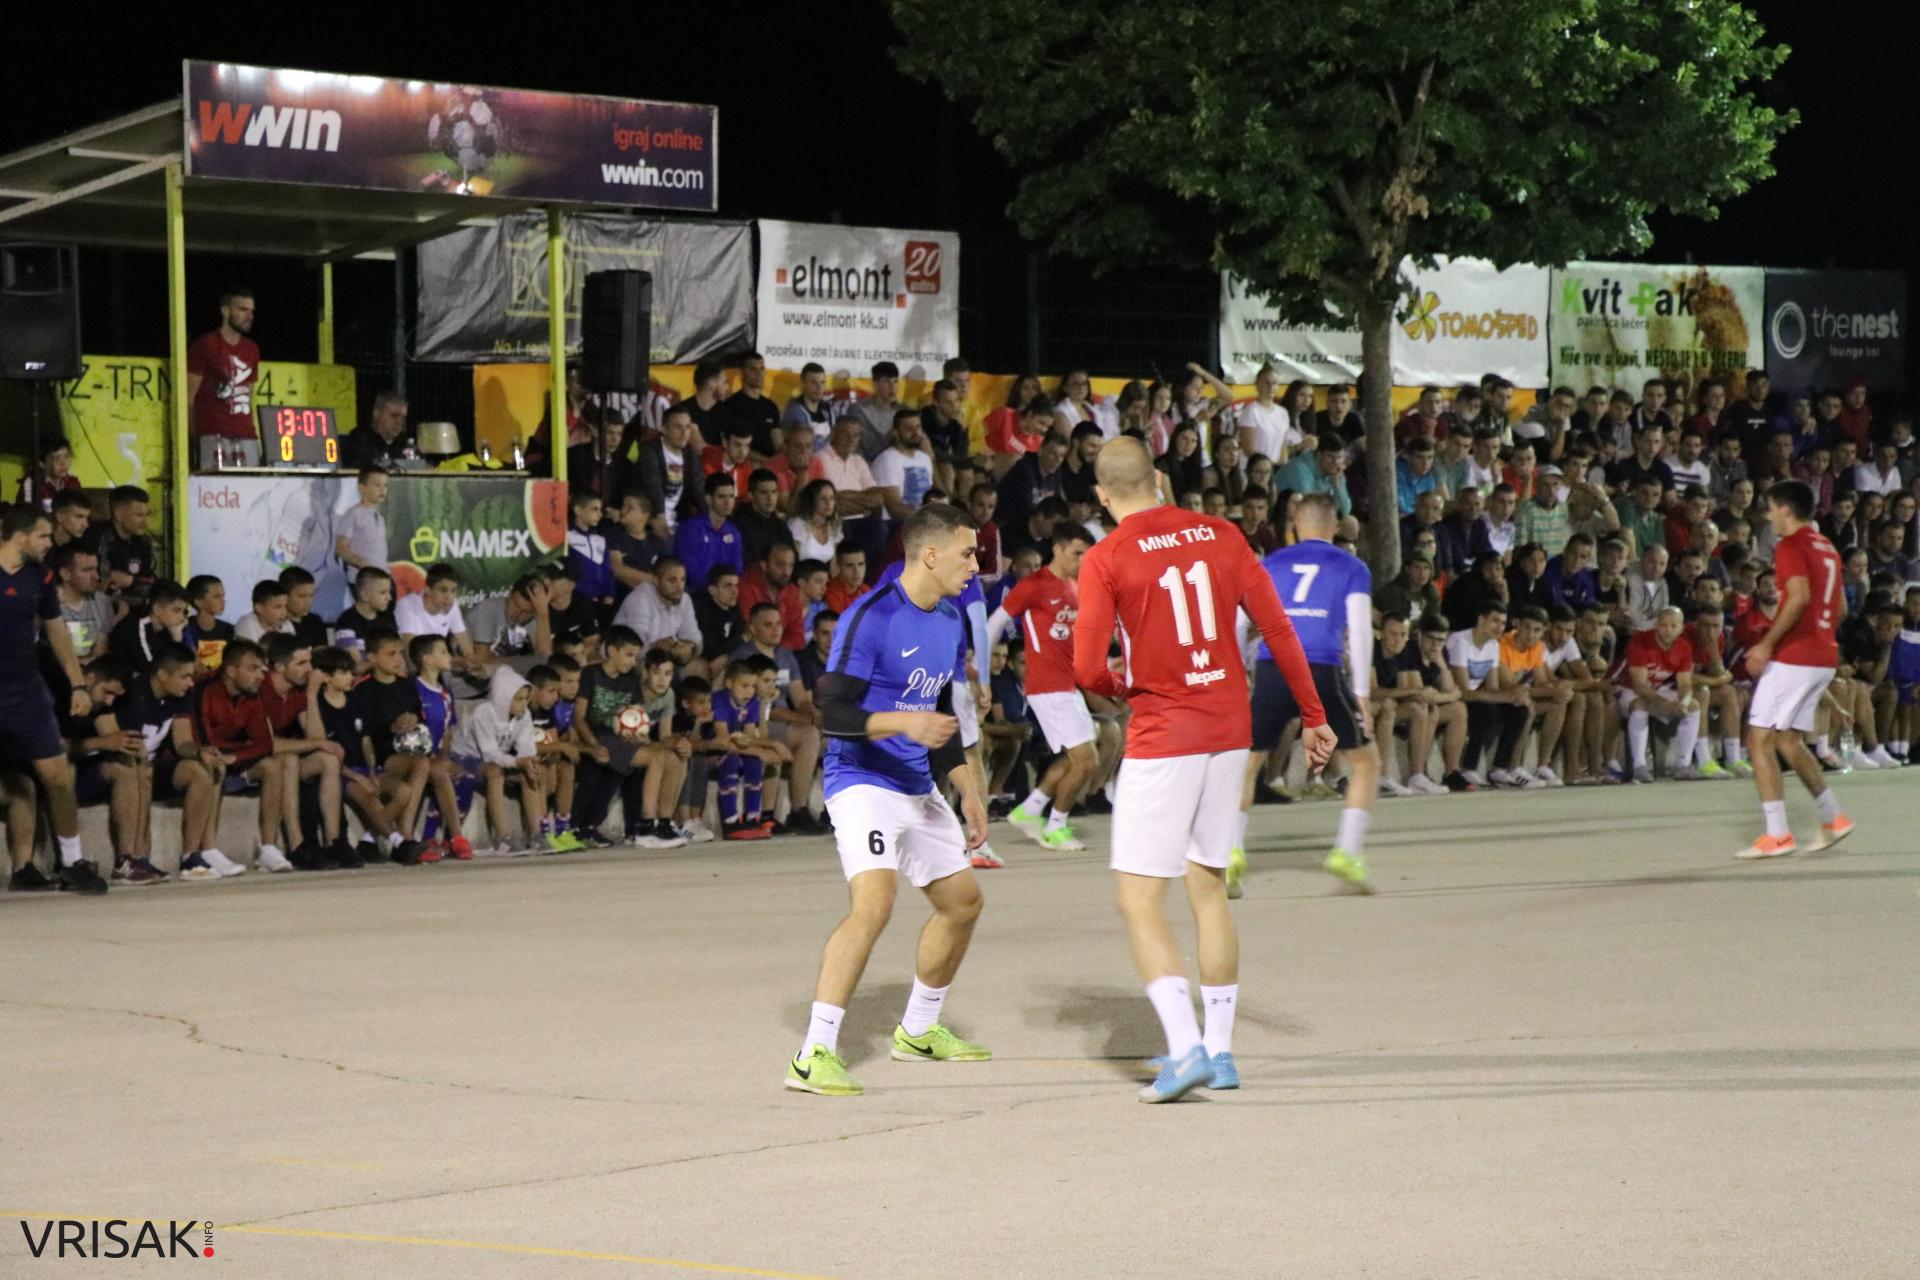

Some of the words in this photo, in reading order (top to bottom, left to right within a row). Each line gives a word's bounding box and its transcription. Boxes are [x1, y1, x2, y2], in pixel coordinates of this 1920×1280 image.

[614, 124, 650, 153] igraj
[653, 129, 704, 151] online
[601, 159, 704, 189] wwin.com
[907, 248, 942, 277] 20
[792, 256, 891, 301] elmont
[1562, 279, 1622, 316] Kvit
[278, 408, 327, 437] 13:07
[281, 436, 293, 461] 0
[326, 438, 337, 463] 0
[198, 485, 240, 509] leda
[440, 528, 531, 559] NAMEX
[1137, 532, 1182, 553] MNK
[1180, 524, 1216, 543] TIĆI
[1292, 563, 1320, 603] 7
[1158, 560, 1217, 647] 11
[868, 830, 885, 856] 6
